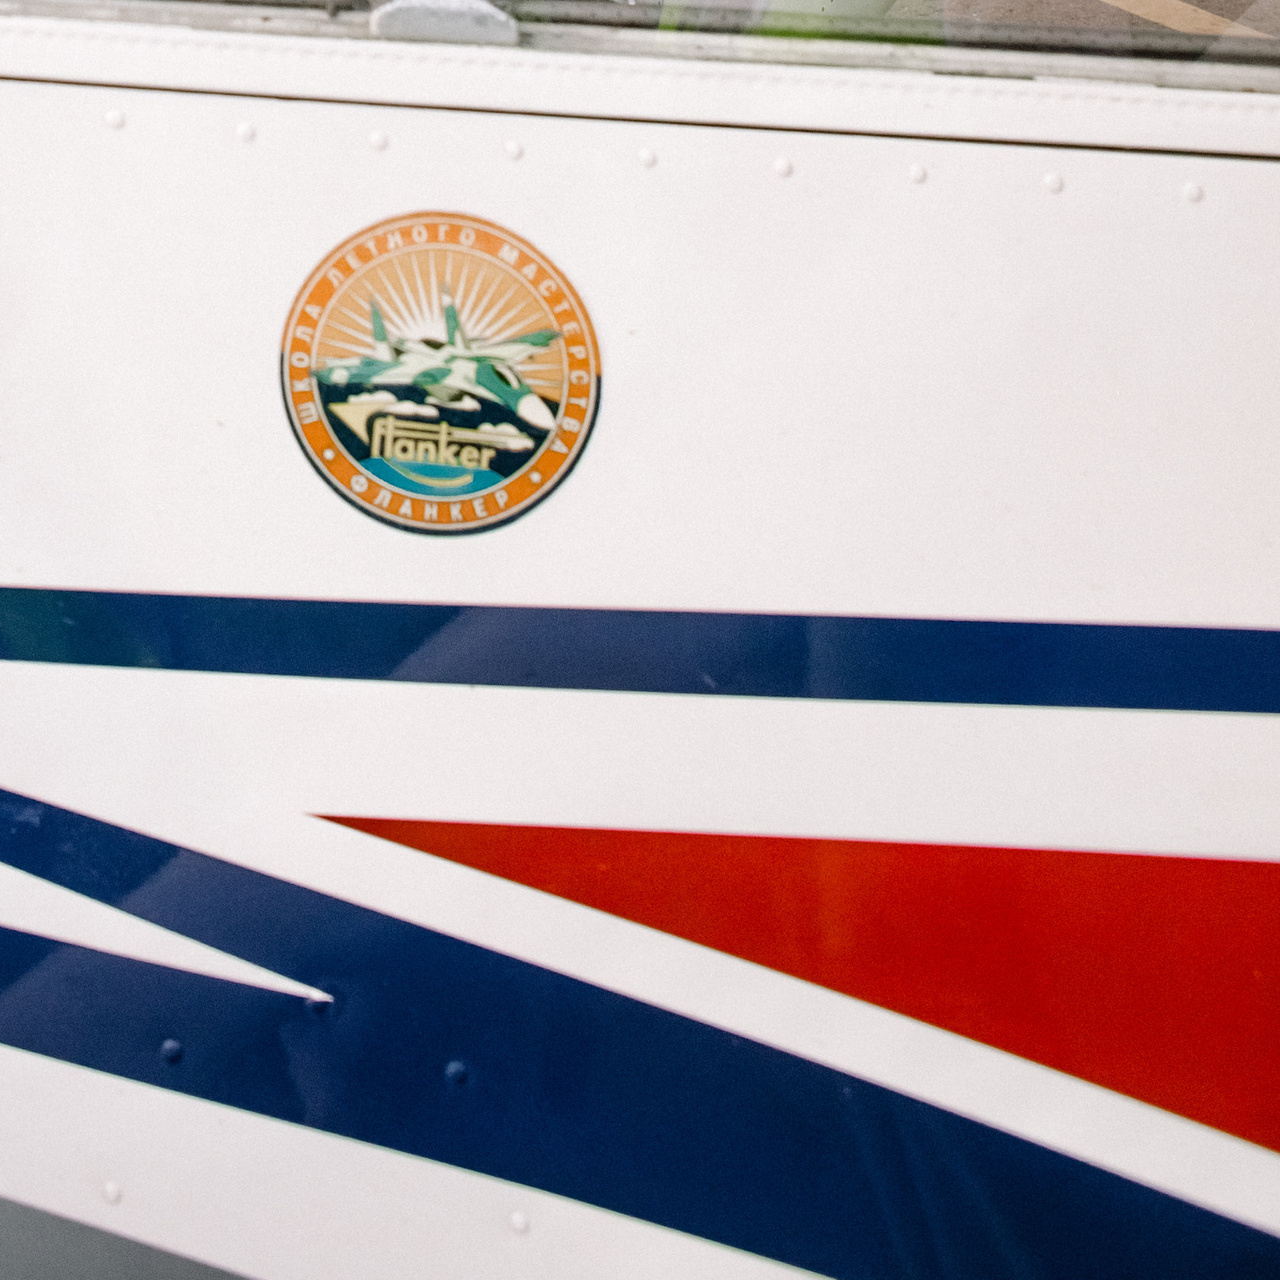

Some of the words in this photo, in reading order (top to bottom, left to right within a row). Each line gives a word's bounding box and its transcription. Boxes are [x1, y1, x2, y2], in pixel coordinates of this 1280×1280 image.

[290, 301, 324, 426] ШКОЛА
[325, 223, 477, 289] ЛЕТНОГО
[498, 237, 590, 455] МАСТЕРСТВА
[370, 416, 498, 470] flanker
[350, 473, 509, 522] ФЛАНКЕР
